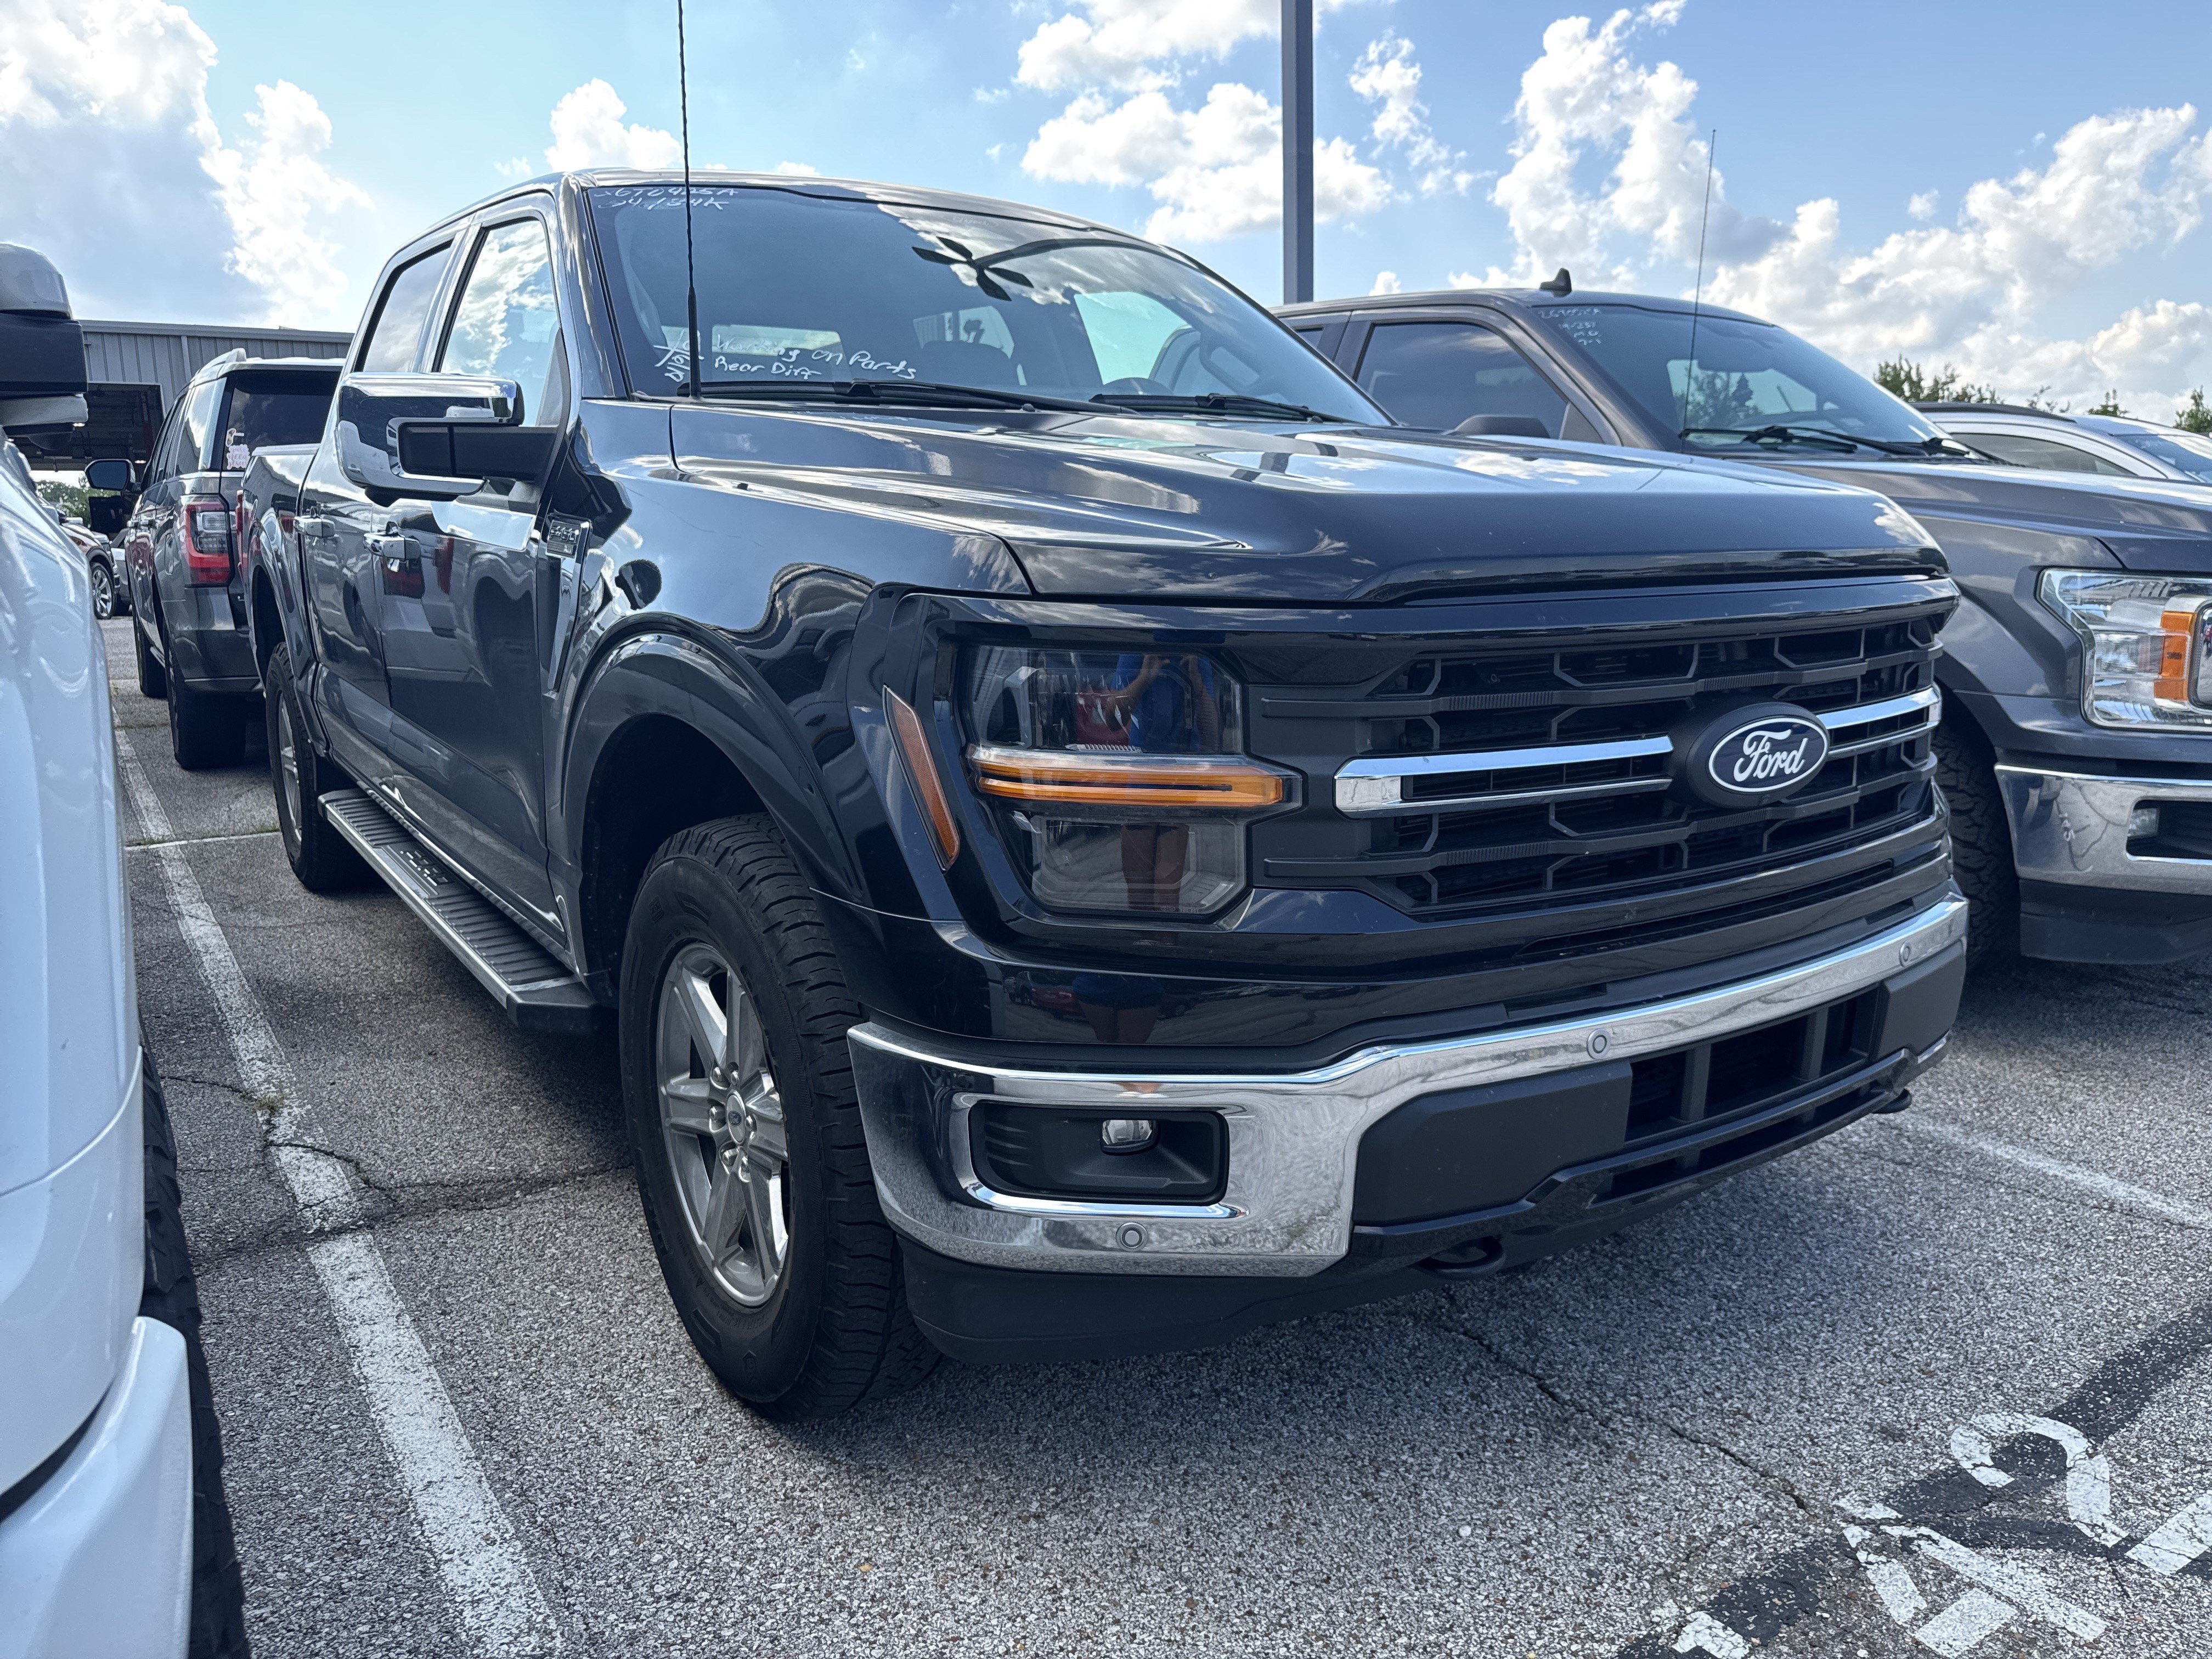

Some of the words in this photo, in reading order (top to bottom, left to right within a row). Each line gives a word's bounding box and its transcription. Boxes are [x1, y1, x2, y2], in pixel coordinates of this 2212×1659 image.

[714, 356, 765, 371] Rear
[718, 334, 801, 363] Working
[849, 351, 917, 380] Parts
[1733, 729, 1809, 782] Ford
